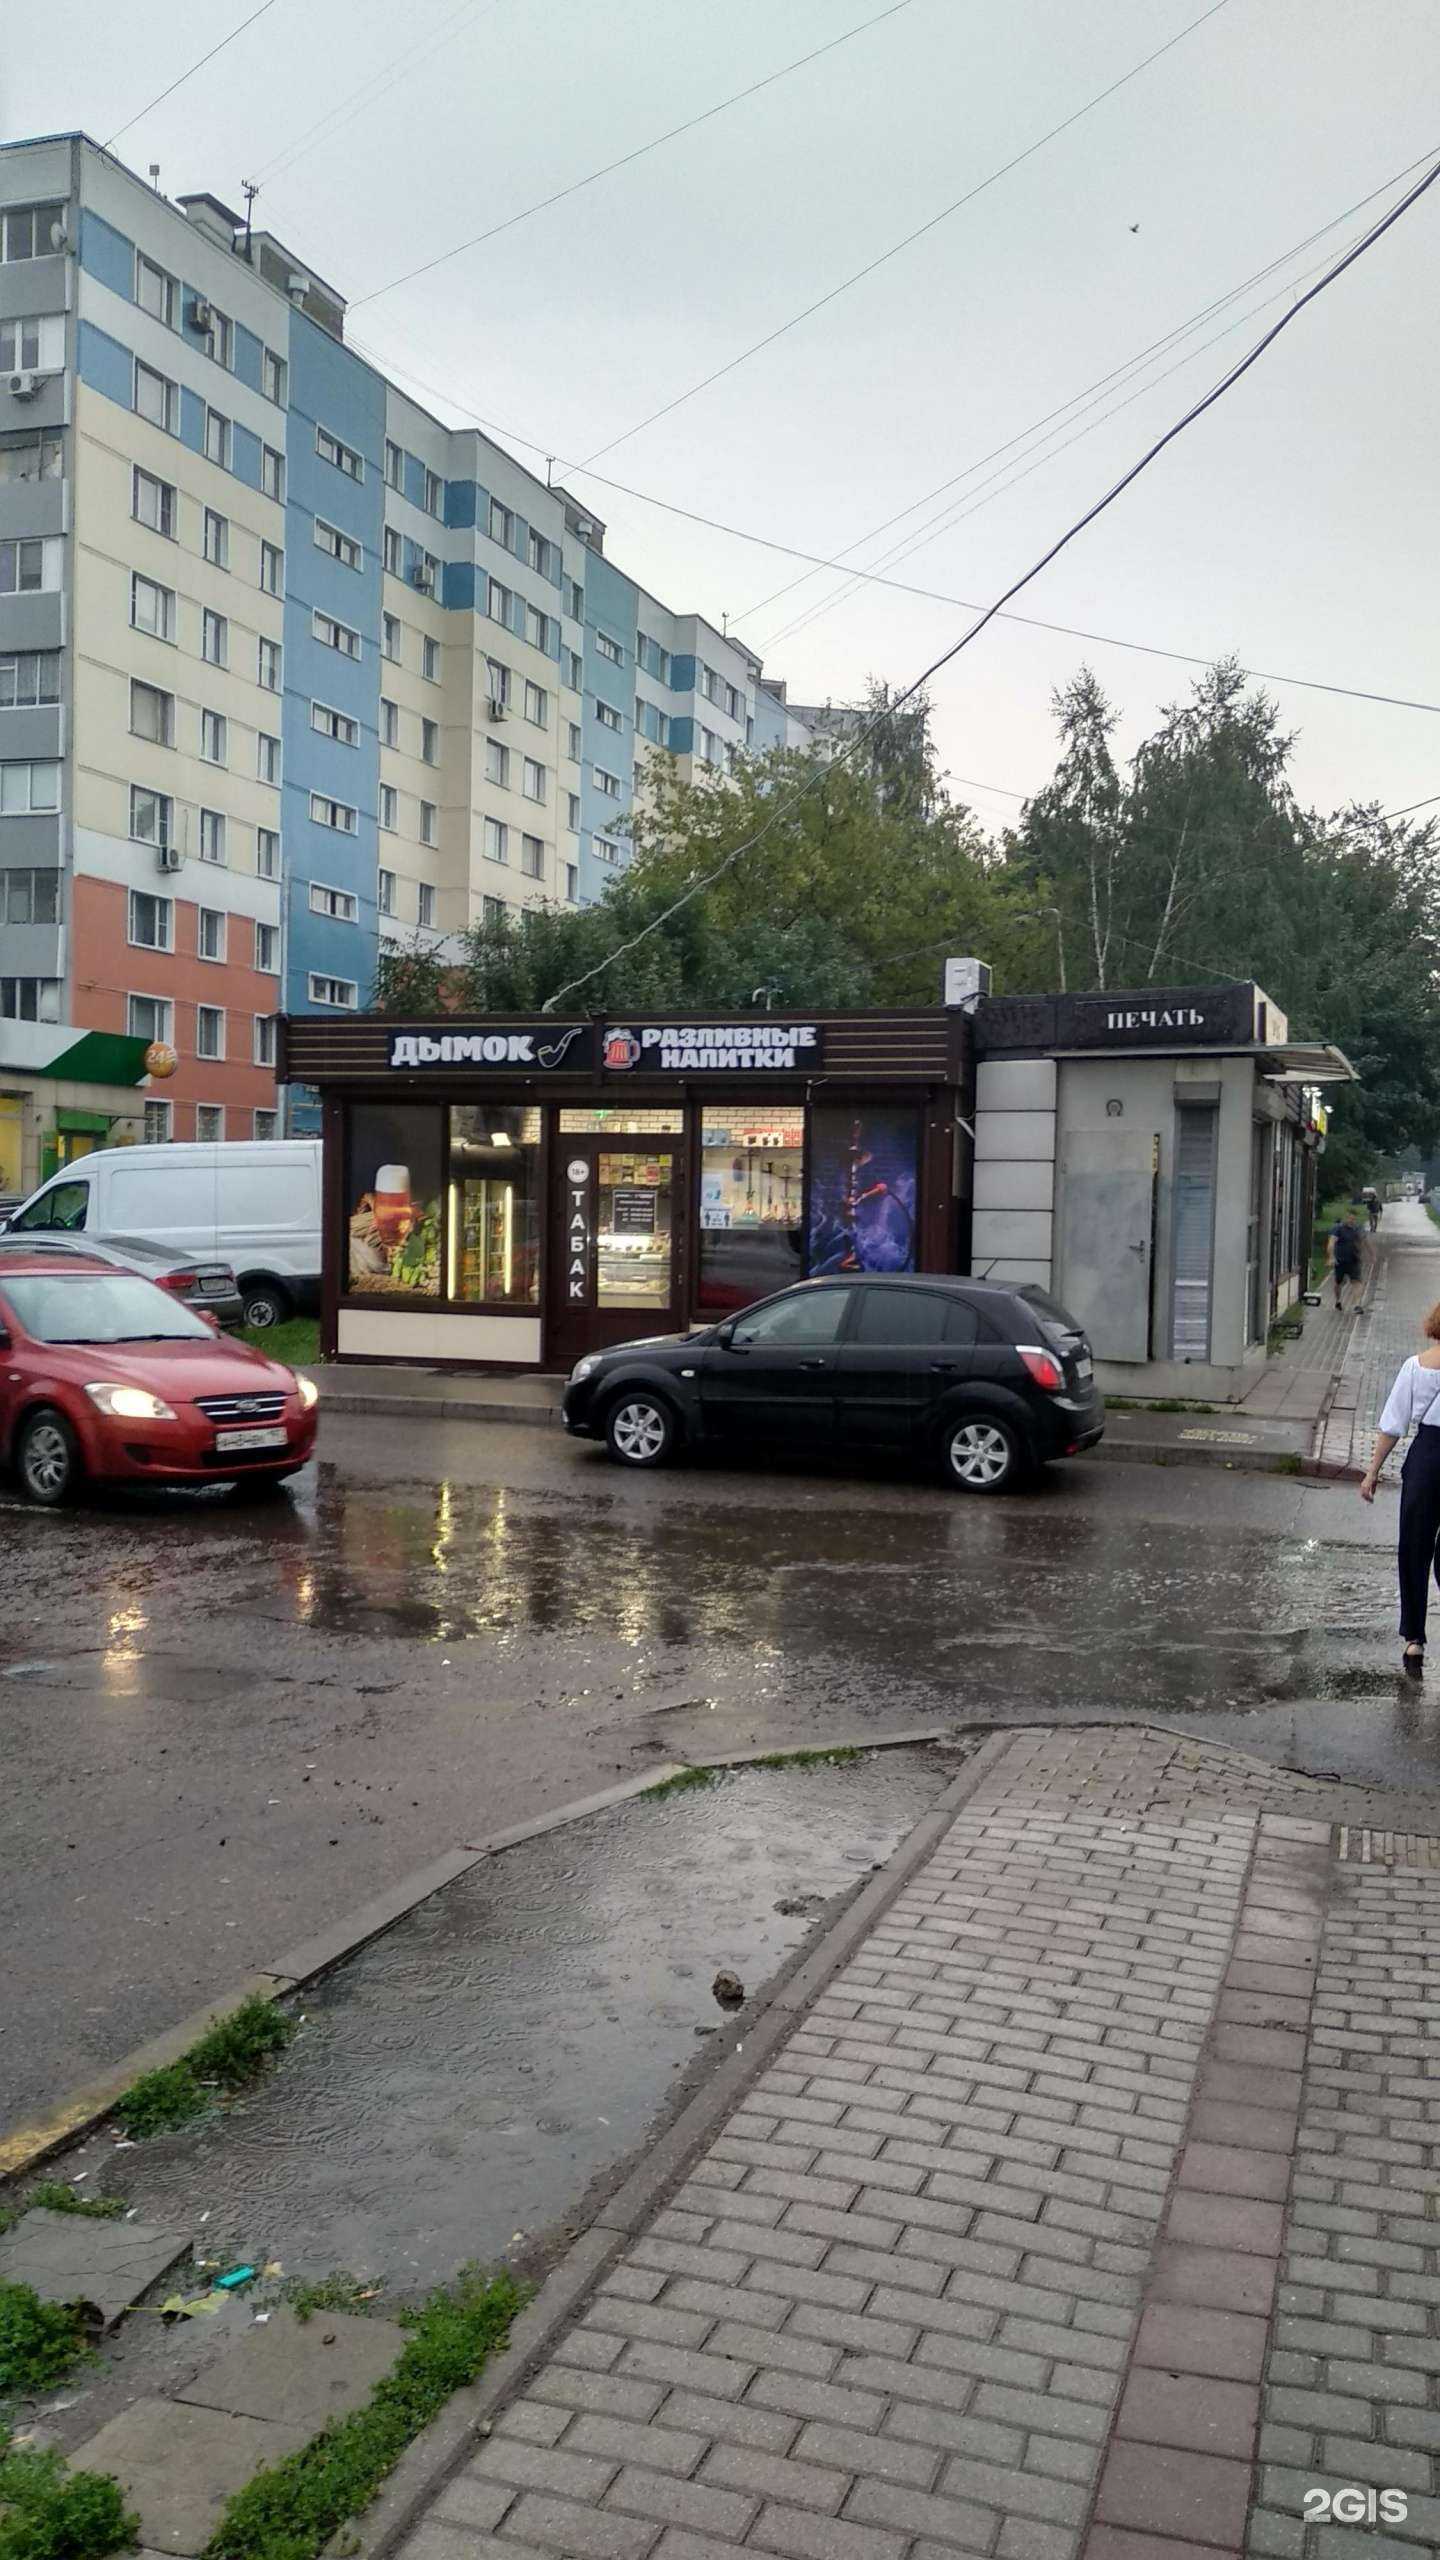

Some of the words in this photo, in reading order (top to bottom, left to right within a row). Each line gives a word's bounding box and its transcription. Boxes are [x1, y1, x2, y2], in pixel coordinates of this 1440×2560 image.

[1107, 1009, 1204, 1029] ПЕЧАТЬ
[641, 1027, 817, 1047] РАЗЛИВНЫЕ
[391, 1035, 535, 1066] ДЫМОК
[661, 1048, 795, 1068] НАПИТКИ
[569, 1190, 586, 1298] ТАБАК
